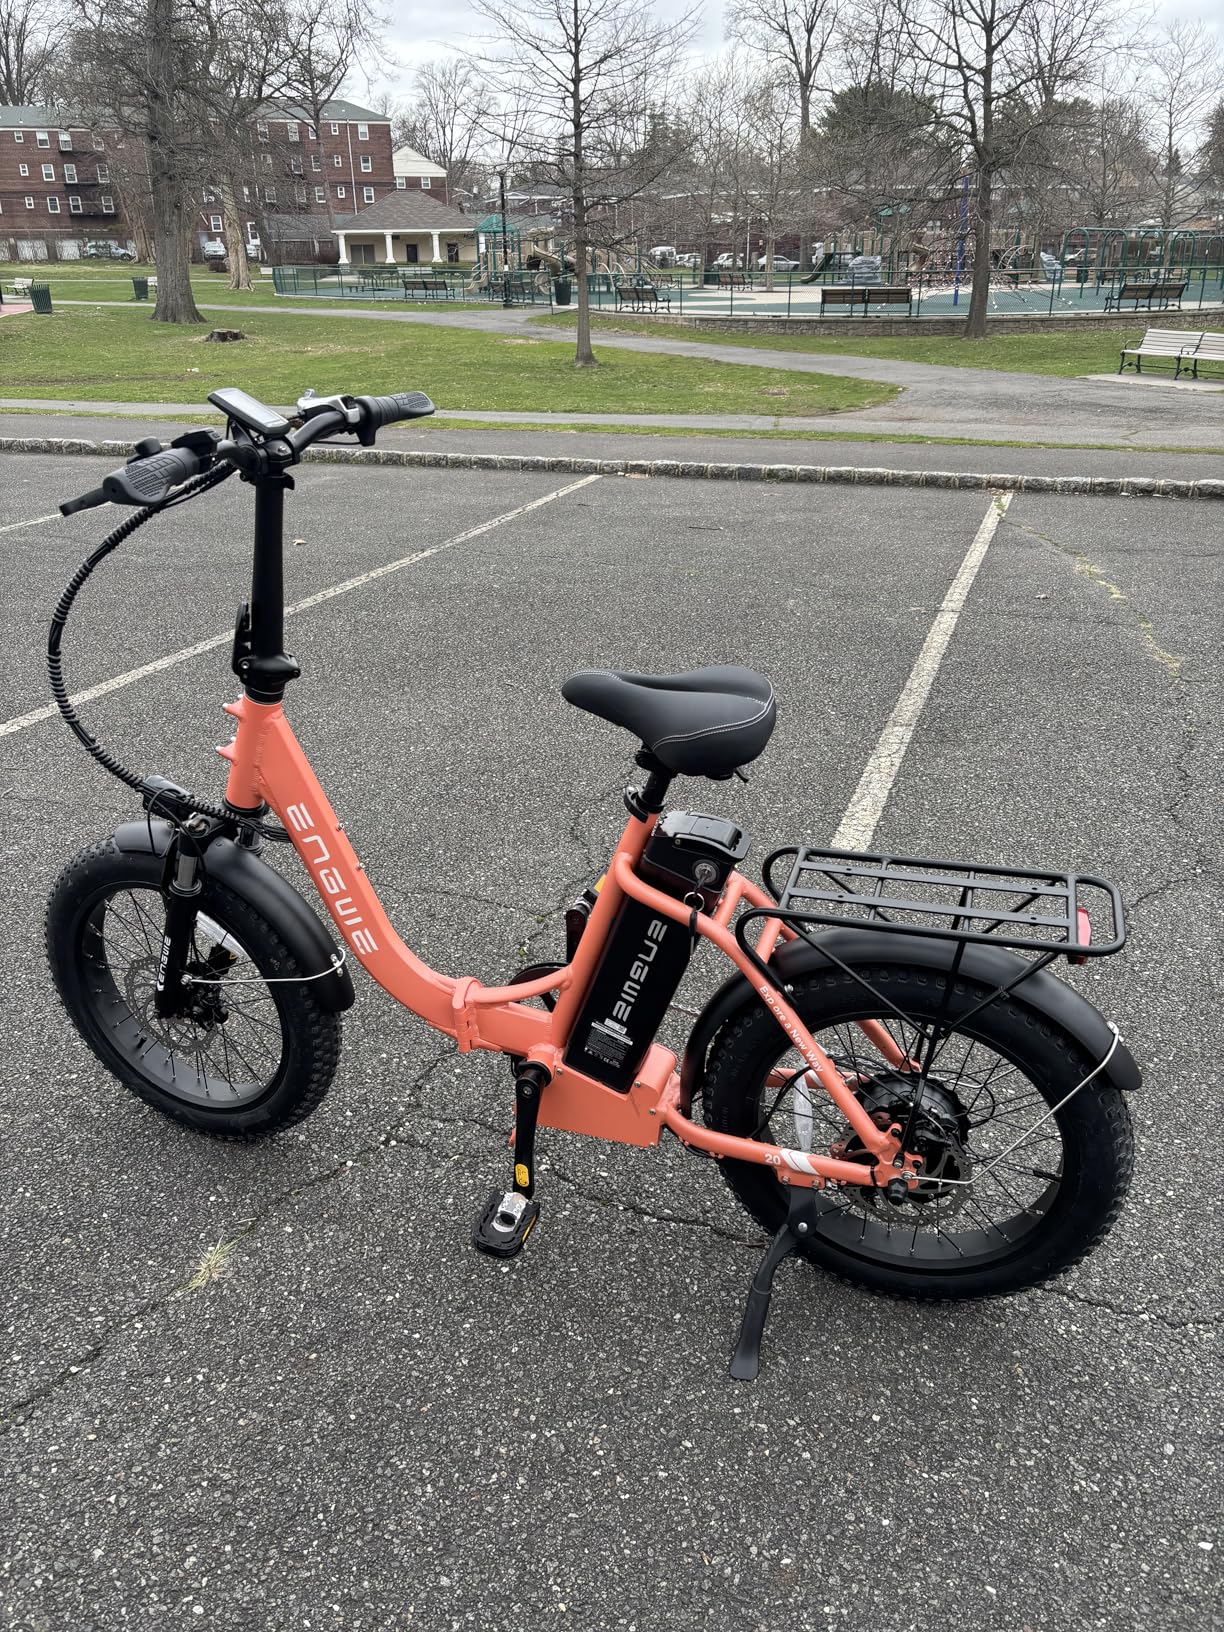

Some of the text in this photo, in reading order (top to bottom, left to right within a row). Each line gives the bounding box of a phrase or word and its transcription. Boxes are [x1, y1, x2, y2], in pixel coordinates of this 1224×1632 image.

[760, 985, 786, 1021] Expore
[790, 1029, 808, 1050] New
[806, 1050, 823, 1072] Way
[764, 1153, 781, 1165] 20
